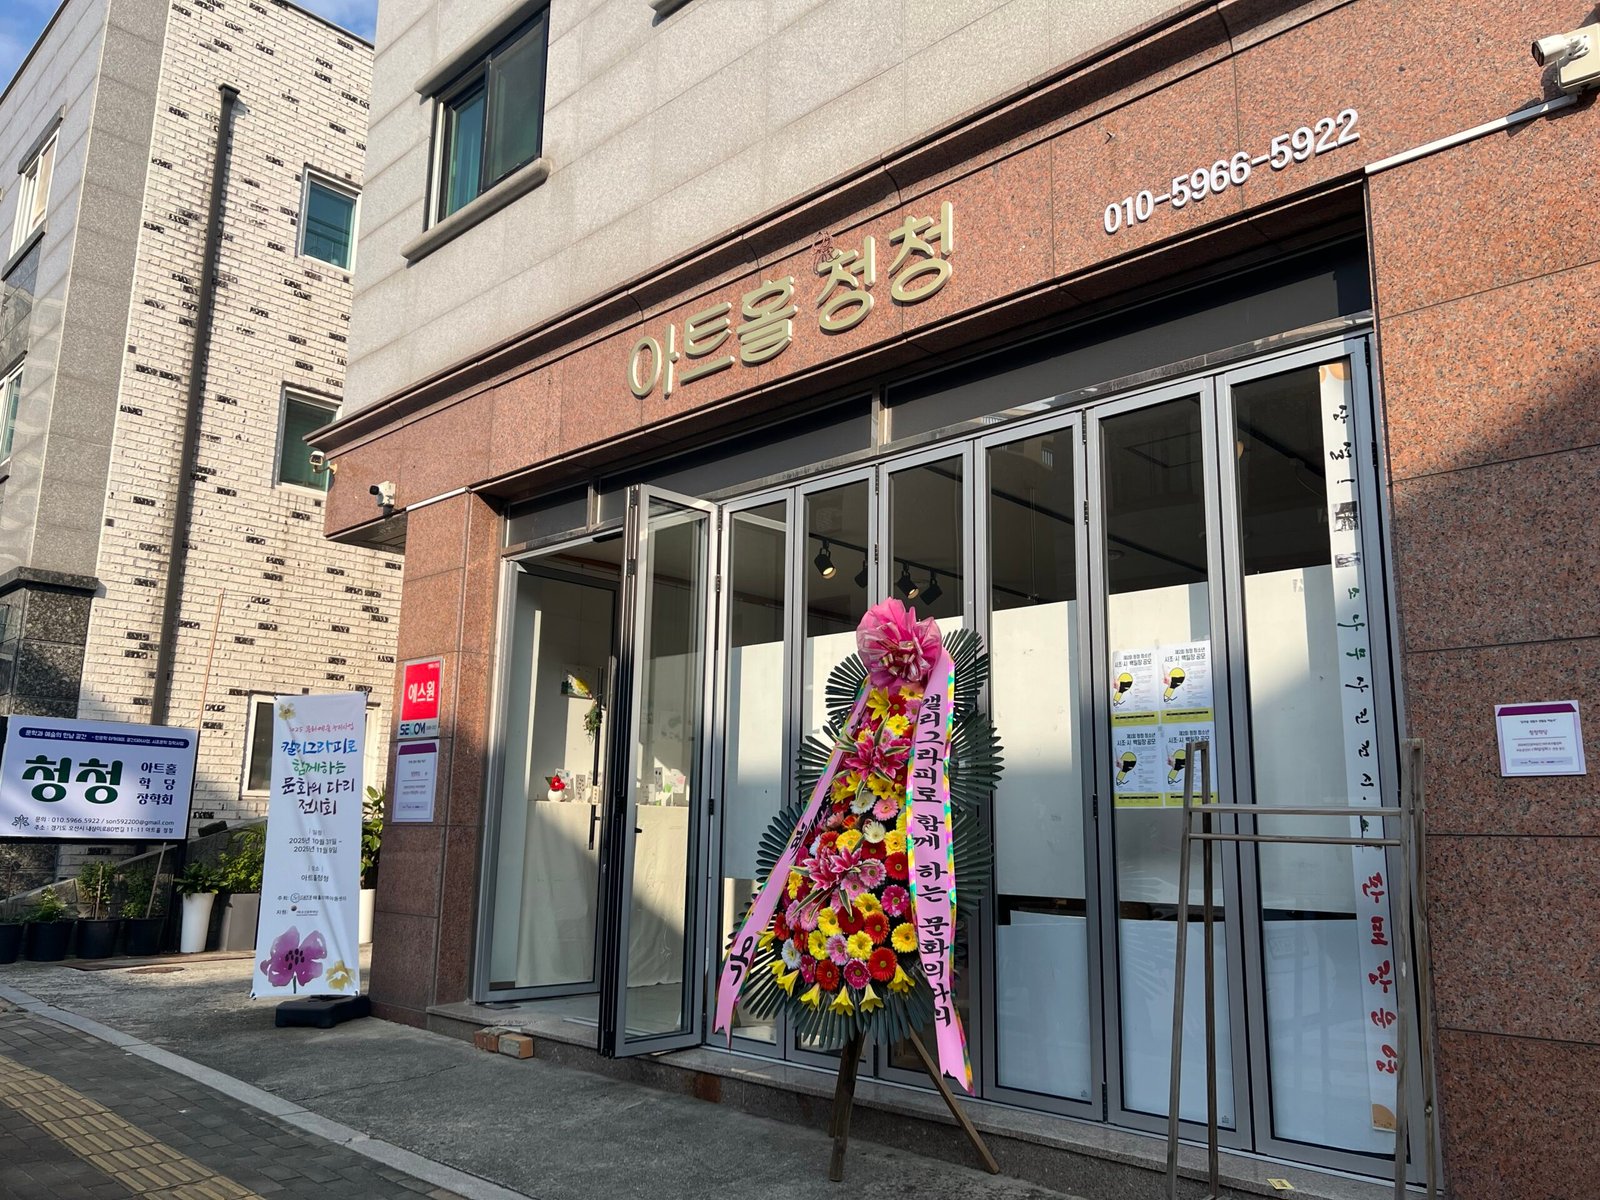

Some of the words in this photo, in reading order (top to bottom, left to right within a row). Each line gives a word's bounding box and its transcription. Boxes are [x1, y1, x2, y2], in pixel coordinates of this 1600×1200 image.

[1104, 109, 1361, 234] 010-5966-5922
[627, 275, 798, 399] 아트홀
[816, 201, 953, 334] 청청
[408, 681, 435, 704] 에스원
[399, 722, 426, 736] SECOM
[281, 738, 358, 756] 캘리그라피로
[141, 762, 177, 775] 아트홀
[292, 759, 346, 776] 함께하는
[22, 754, 123, 805] 청청
[281, 777, 322, 797] 문화의
[326, 778, 355, 793] 다리
[137, 793, 174, 806] 장학회
[298, 797, 337, 816] 전시회
[52, 816, 100, 824] 010.5966.5922
[913, 814, 945, 850] 함께
[916, 862, 948, 902] 하는
